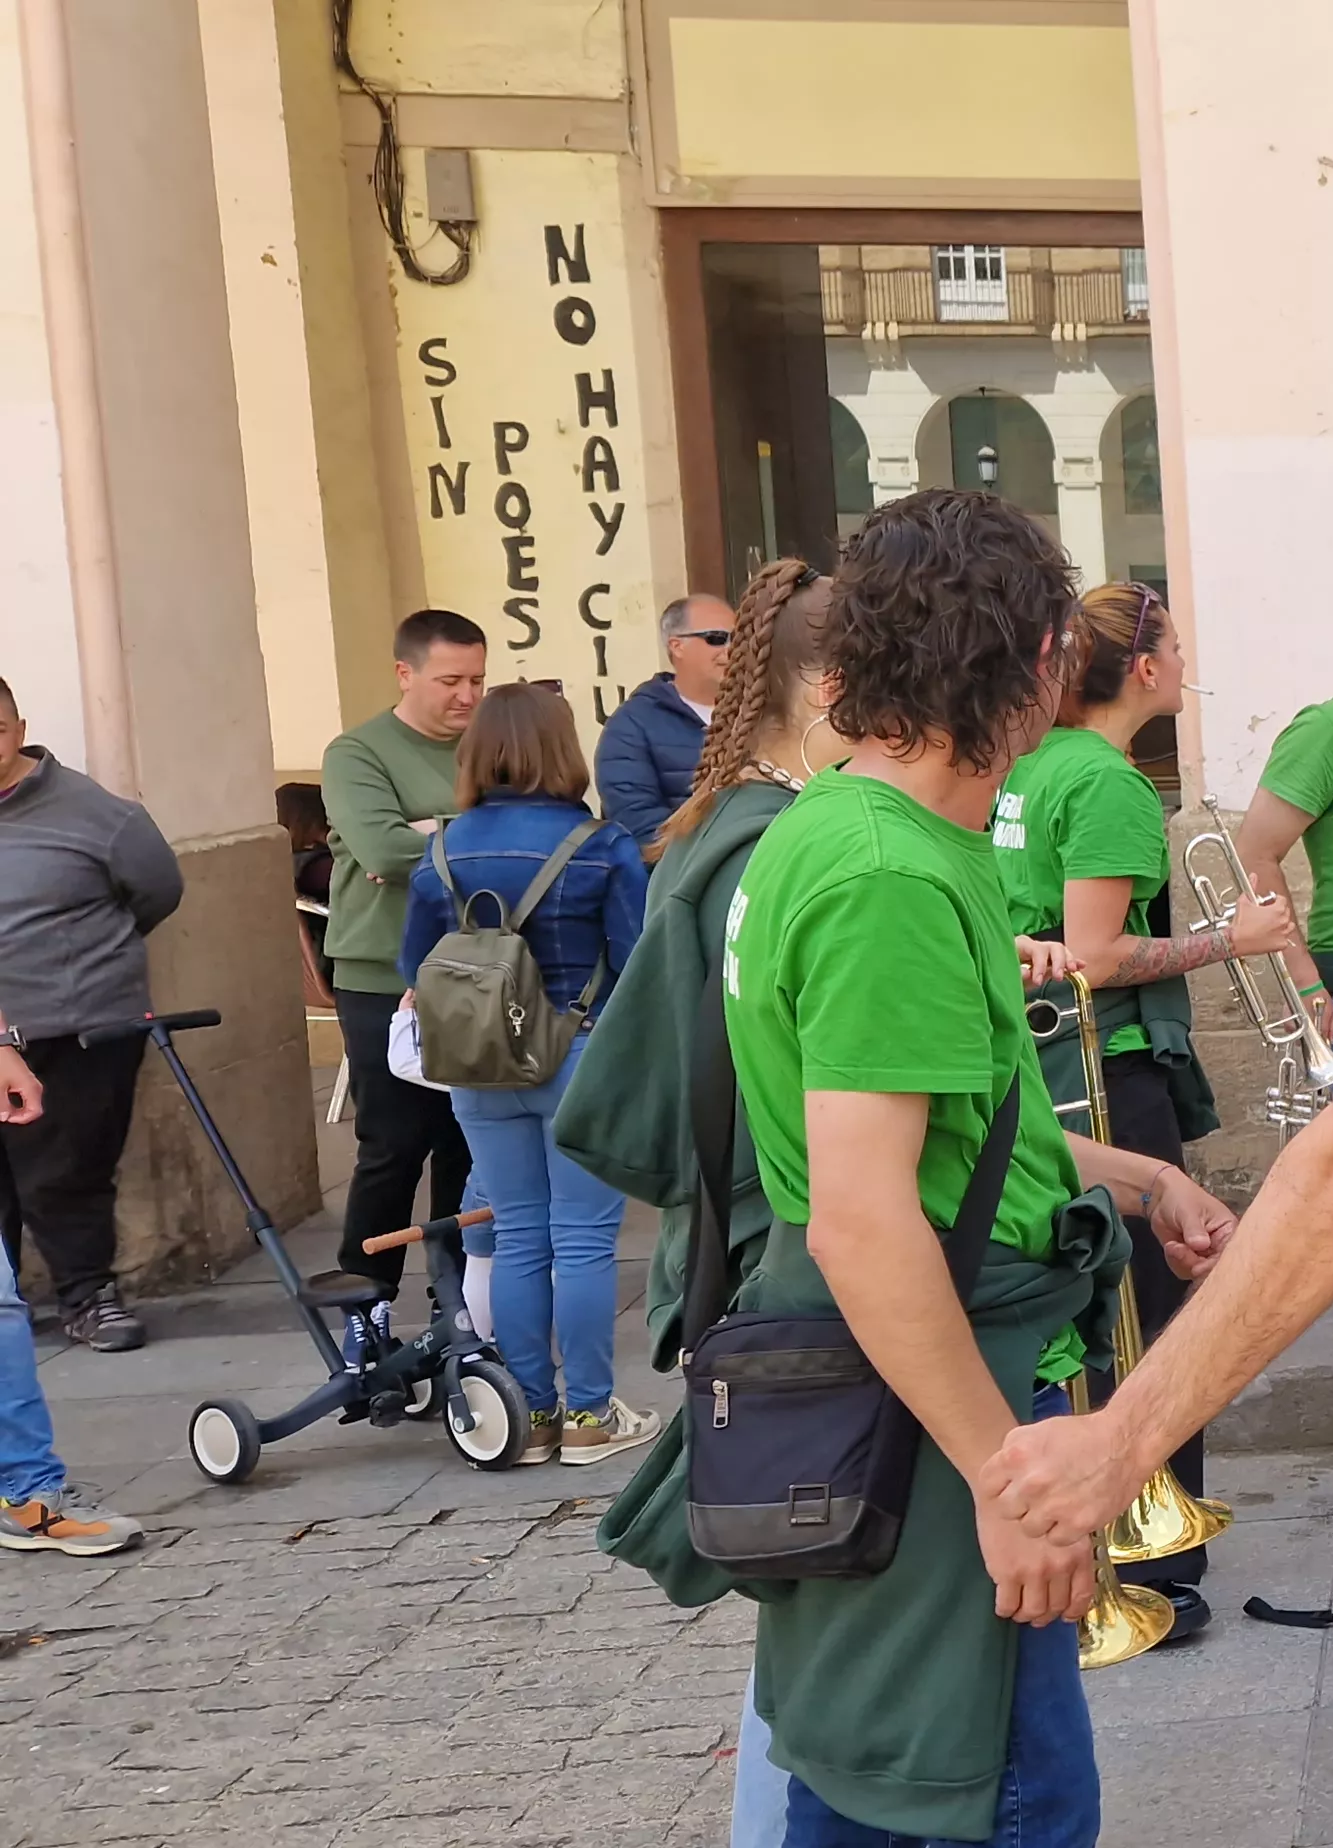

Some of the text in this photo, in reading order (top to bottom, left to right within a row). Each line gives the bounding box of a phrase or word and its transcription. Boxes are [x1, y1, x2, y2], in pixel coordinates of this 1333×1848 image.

[418, 337, 470, 519] SIN
[544, 223, 597, 346] NO
[574, 368, 625, 556] HAY
